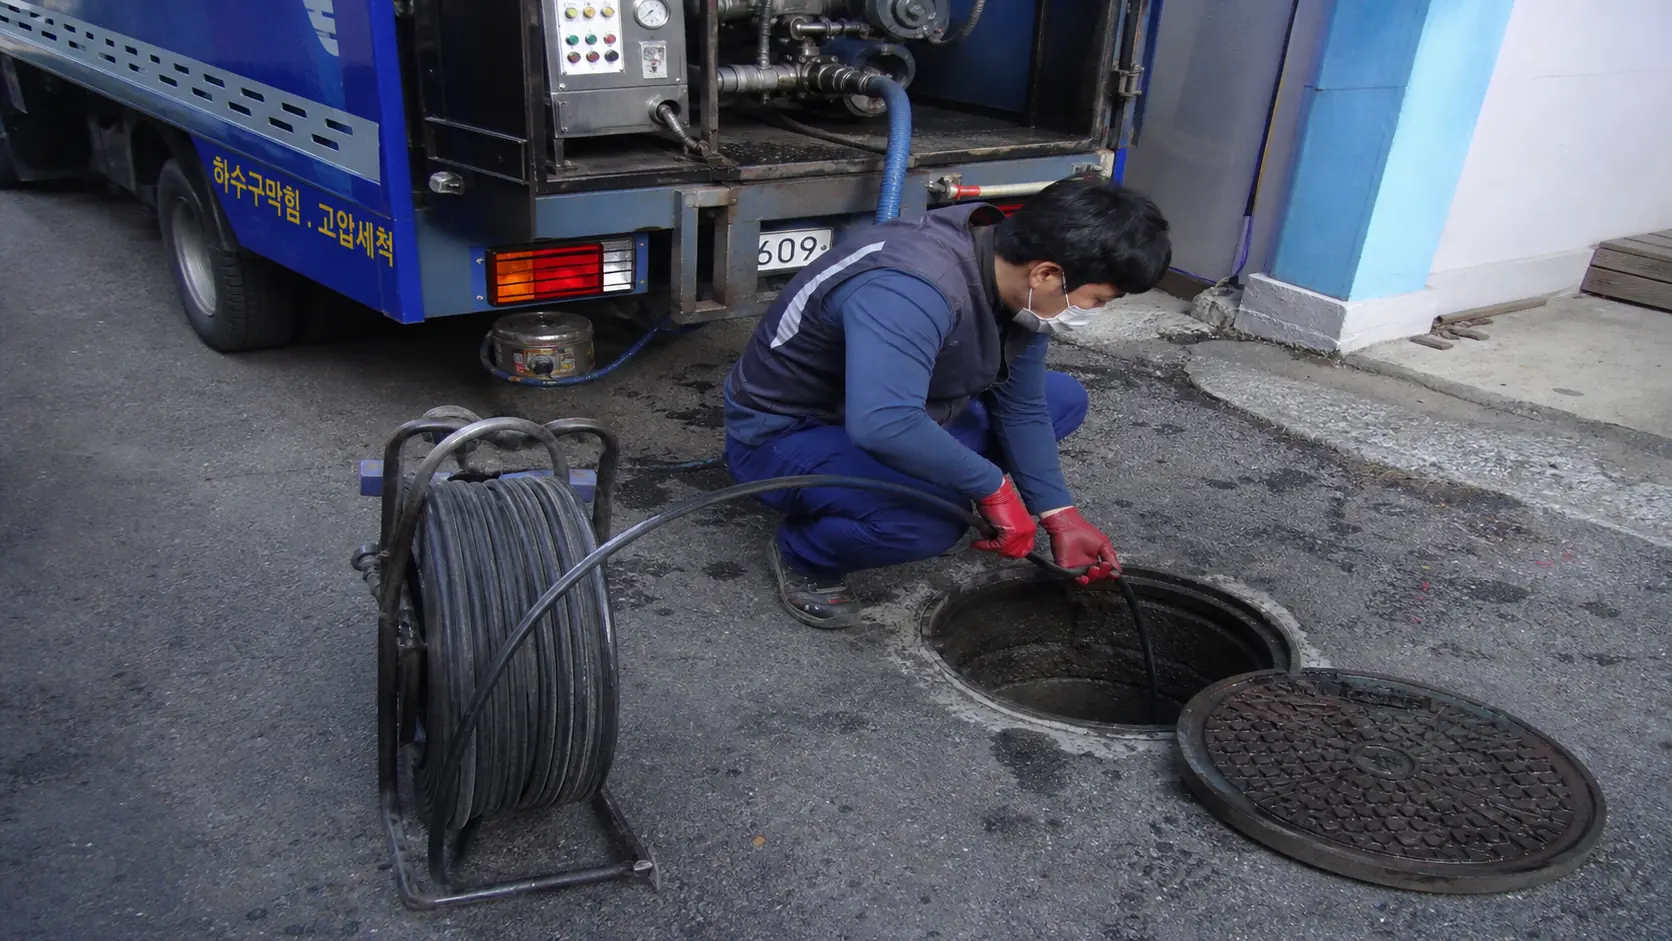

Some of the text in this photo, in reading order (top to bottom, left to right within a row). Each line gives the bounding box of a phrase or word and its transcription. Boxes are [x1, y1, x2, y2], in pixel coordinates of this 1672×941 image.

[213, 156, 301, 225] 하수구막힘
[317, 202, 394, 268] 고압세척
[758, 236, 817, 265] 609
